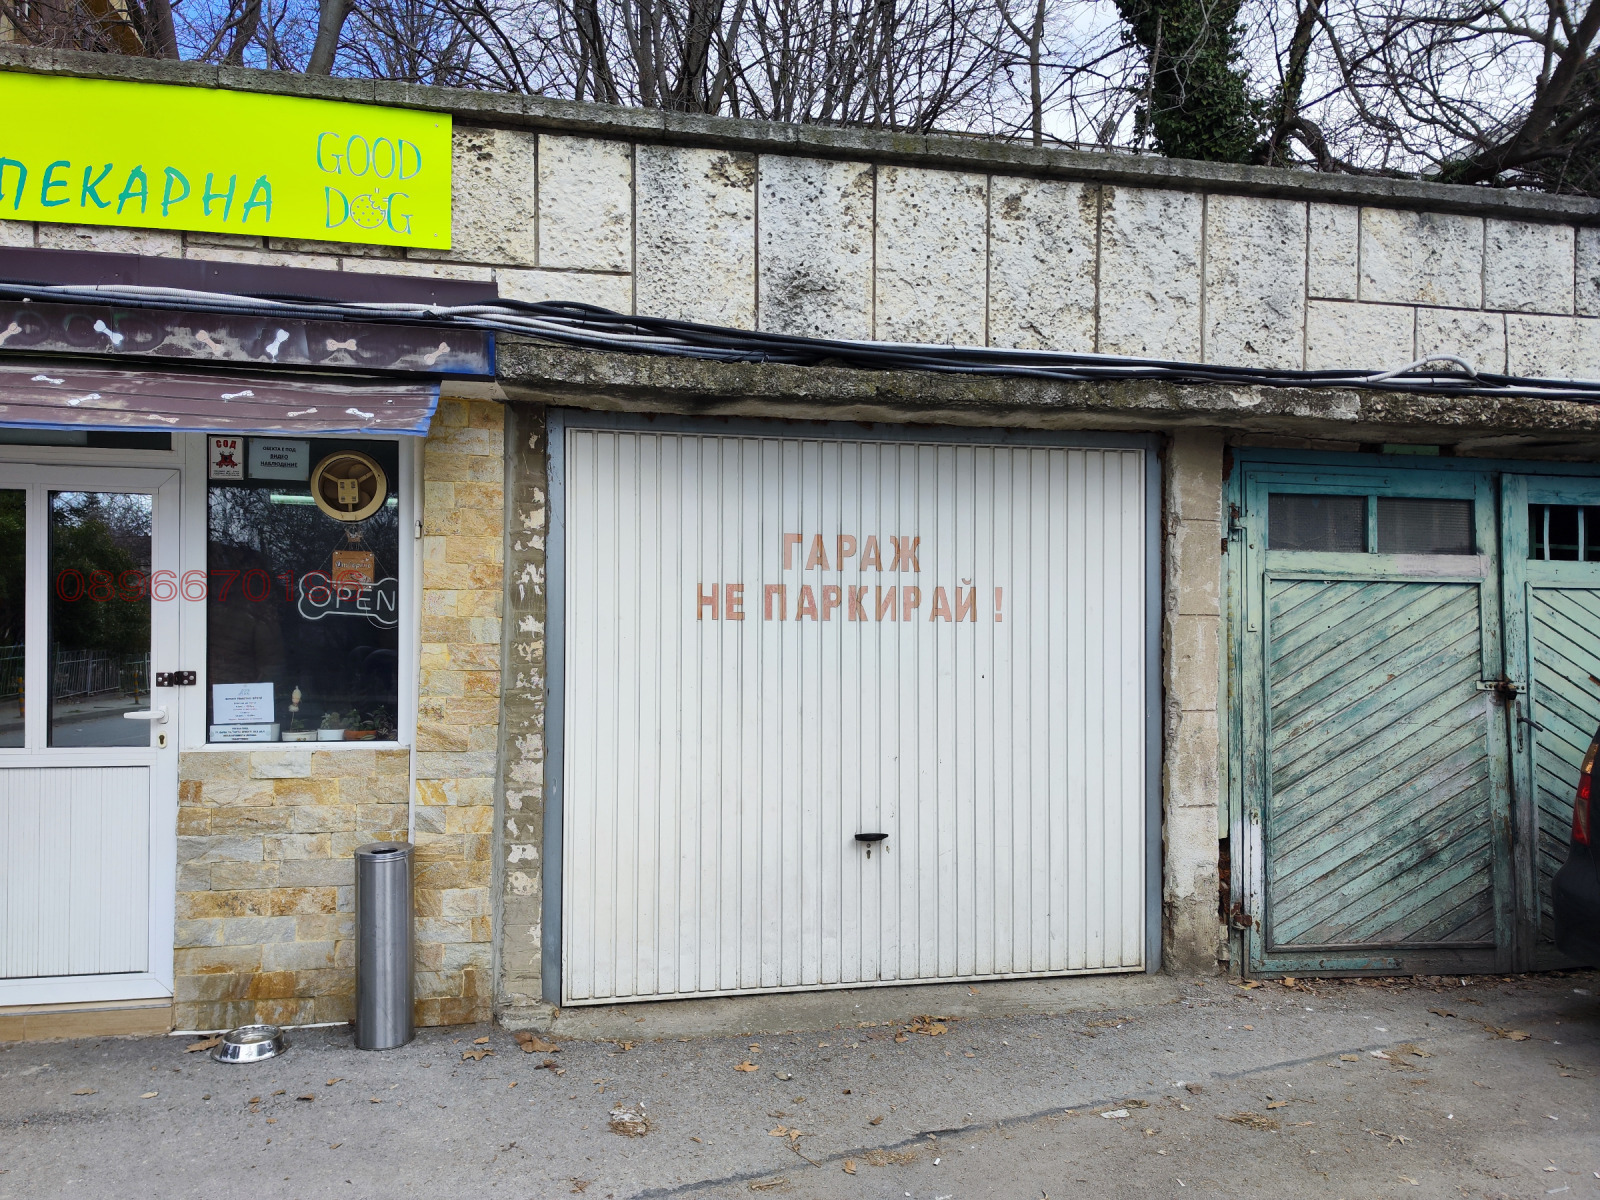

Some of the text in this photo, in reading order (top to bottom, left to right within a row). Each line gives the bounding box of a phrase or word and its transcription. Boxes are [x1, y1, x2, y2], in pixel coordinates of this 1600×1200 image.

[316, 132, 422, 180] GOOD
[0, 156, 273, 223] ПЕКАРНА
[325, 186, 414, 235] DOG
[215, 439, 237, 450] СОД
[260, 461, 299, 469] НАБЛЮДЕНИЕ
[783, 533, 921, 573] ГАРАЖ
[308, 586, 396, 612] OPEN
[696, 583, 745, 620] НЕ
